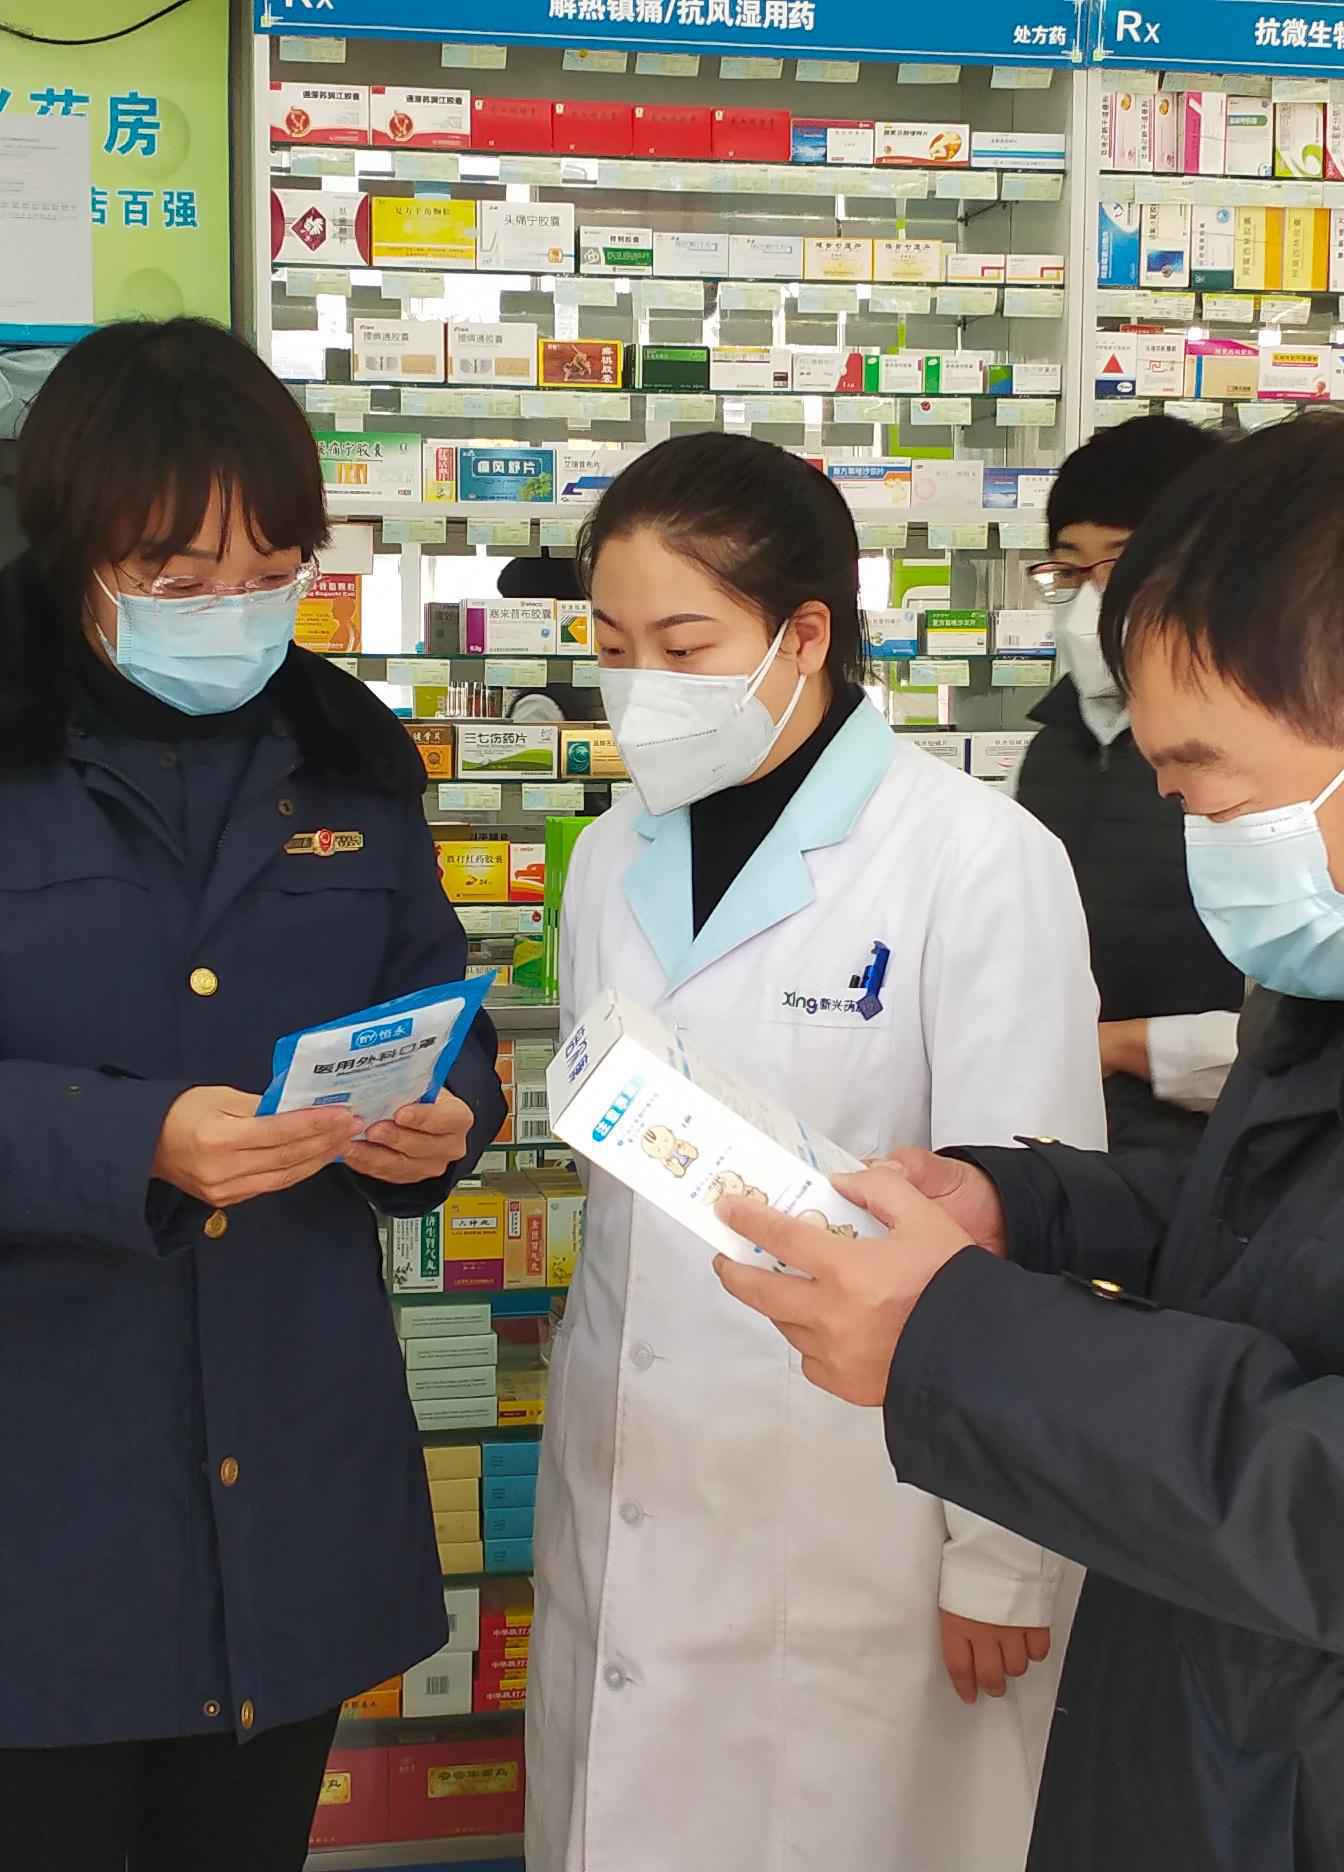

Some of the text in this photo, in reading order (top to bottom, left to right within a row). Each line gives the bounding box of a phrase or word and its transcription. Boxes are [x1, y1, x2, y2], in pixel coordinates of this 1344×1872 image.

[1013, 25, 1067, 46] 处方药
[1116, 10, 1161, 44] Rx
[503, 212, 562, 228] 头痛宁胶囊
[474, 458, 542, 477] 痛风舒片
[463, 731, 529, 746] 三七伤药片
[819, 998, 863, 1013] 新兴药
[312, 1035, 438, 1075] 医用外科口罩
